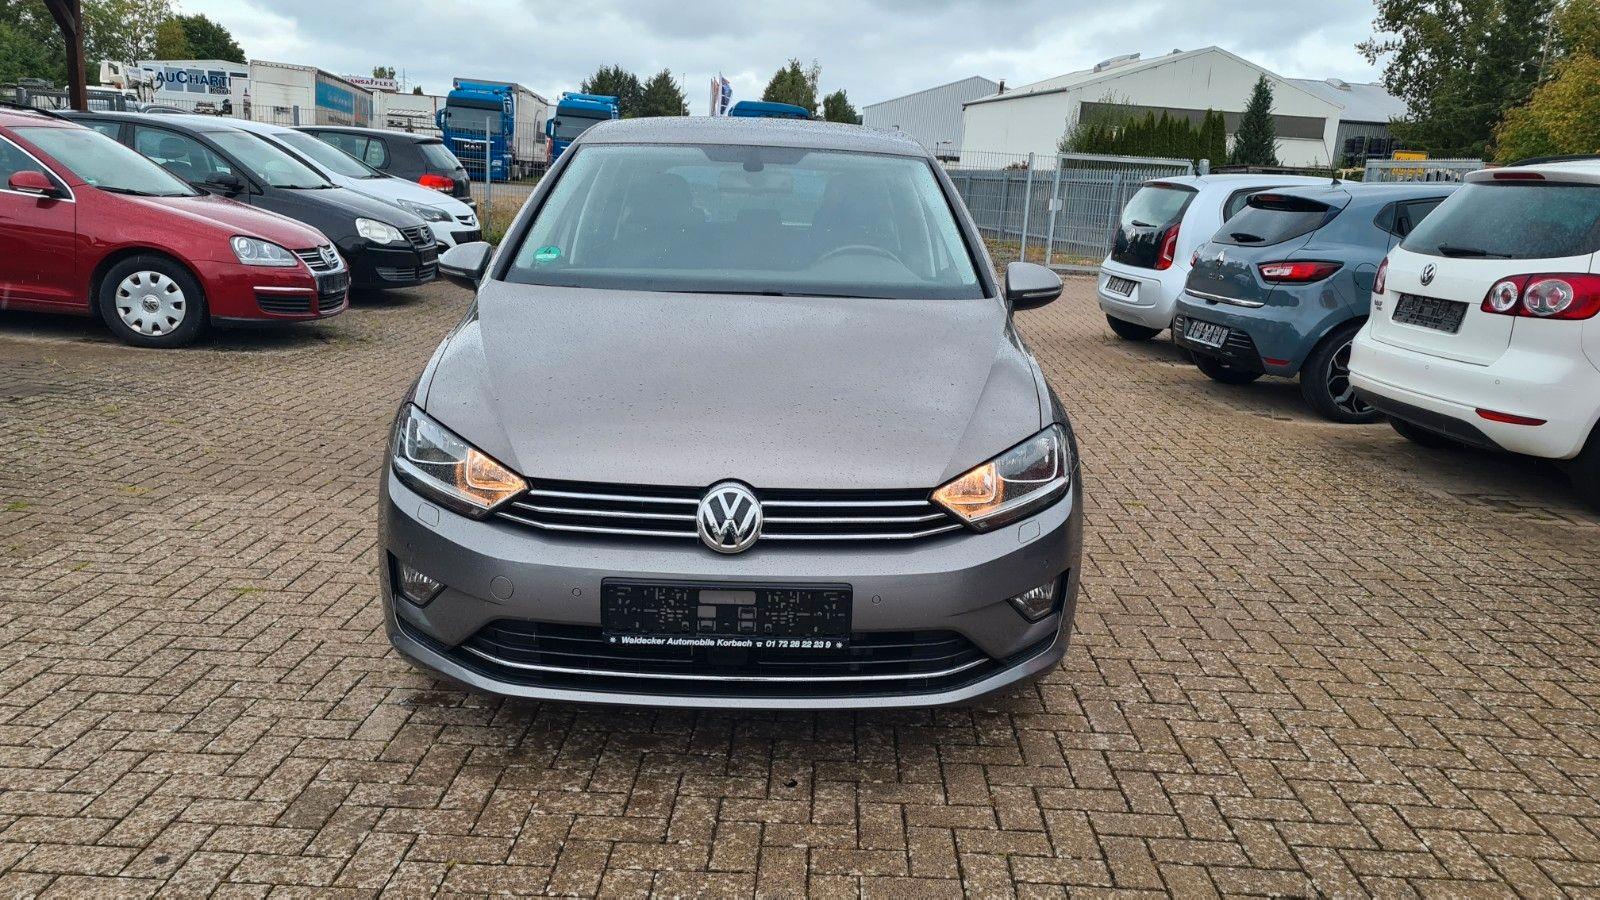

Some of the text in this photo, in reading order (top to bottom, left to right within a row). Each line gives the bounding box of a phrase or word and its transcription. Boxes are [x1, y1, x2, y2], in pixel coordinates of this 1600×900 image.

[699, 486, 761, 550] VW
[621, 636, 665, 645] Waldecker
[667, 637, 715, 646] Automobile
[717, 638, 753, 647] Korbach
[765, 640, 776, 648] 01
[778, 640, 788, 648] 72
